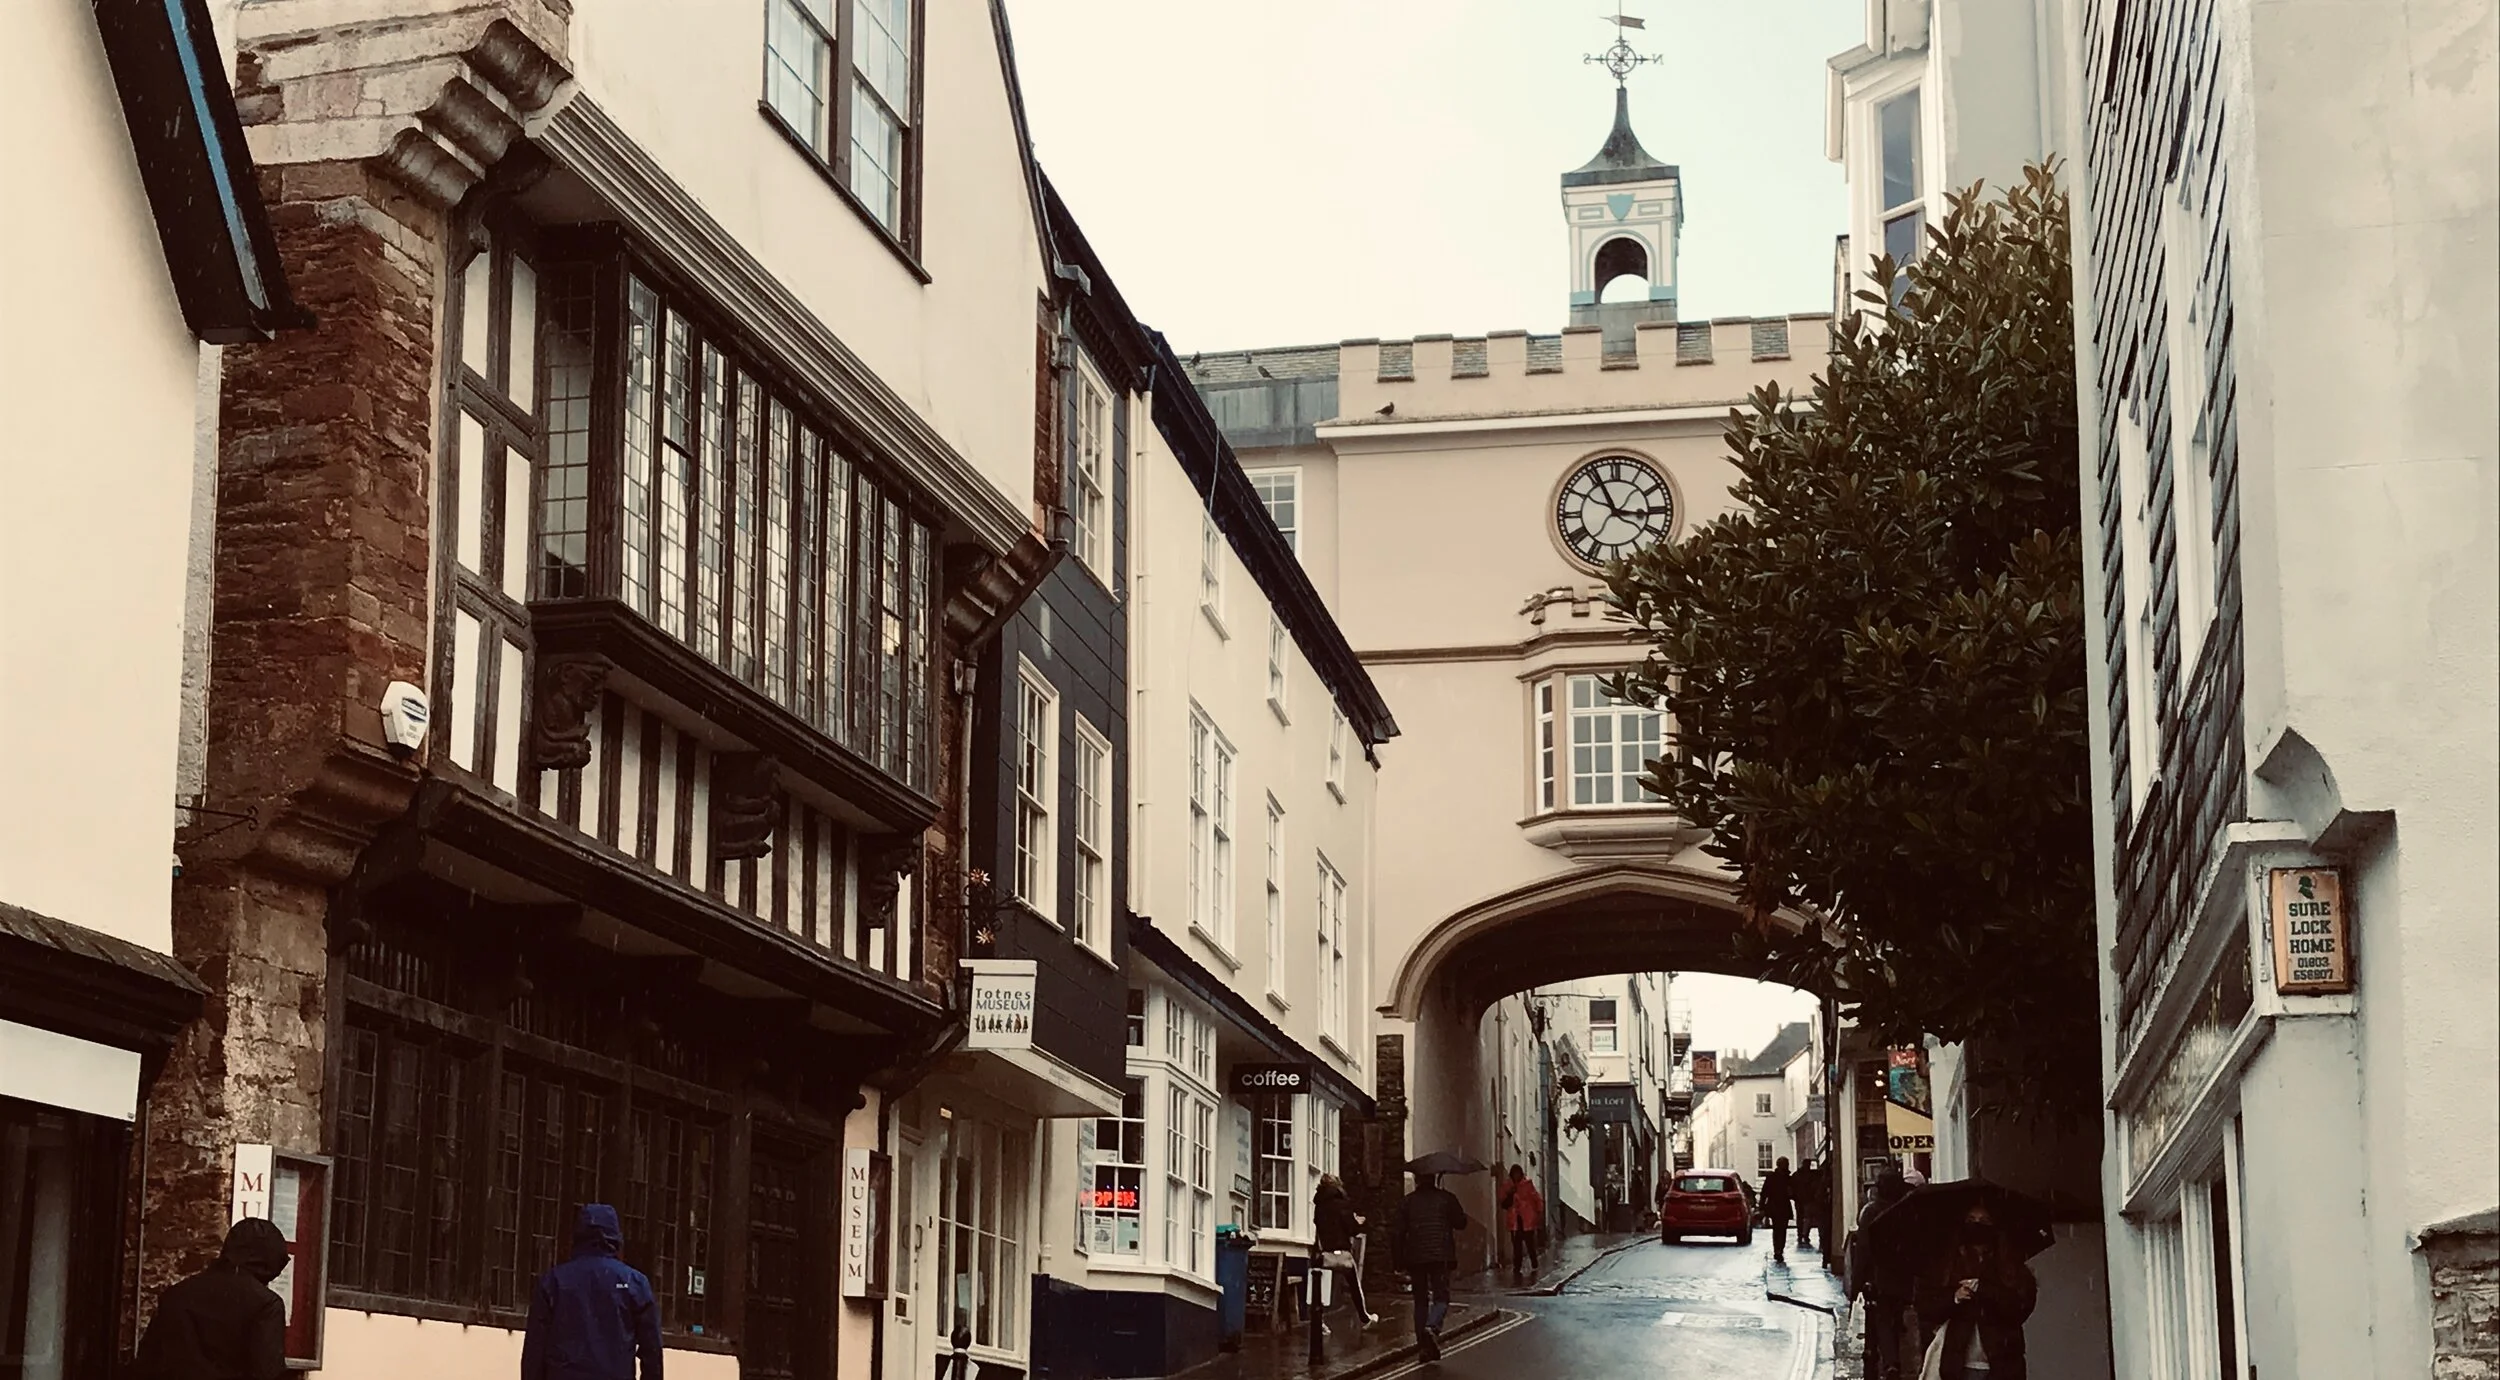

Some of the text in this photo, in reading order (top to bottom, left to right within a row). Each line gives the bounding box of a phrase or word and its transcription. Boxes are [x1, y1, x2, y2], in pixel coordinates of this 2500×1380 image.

[2288, 902, 2331, 917] SURE
[2291, 920, 2332, 935] LOCK
[2290, 939, 2335, 954] HOME
[2297, 957, 2330, 968] 01803
[975, 987, 1031, 1000] Totnes
[975, 999, 1031, 1011] MUSEUM
[1241, 1070, 1300, 1086] coffee
[1889, 1135, 1934, 1149] OPEN
[848, 1166, 865, 1278] MUSEUM
